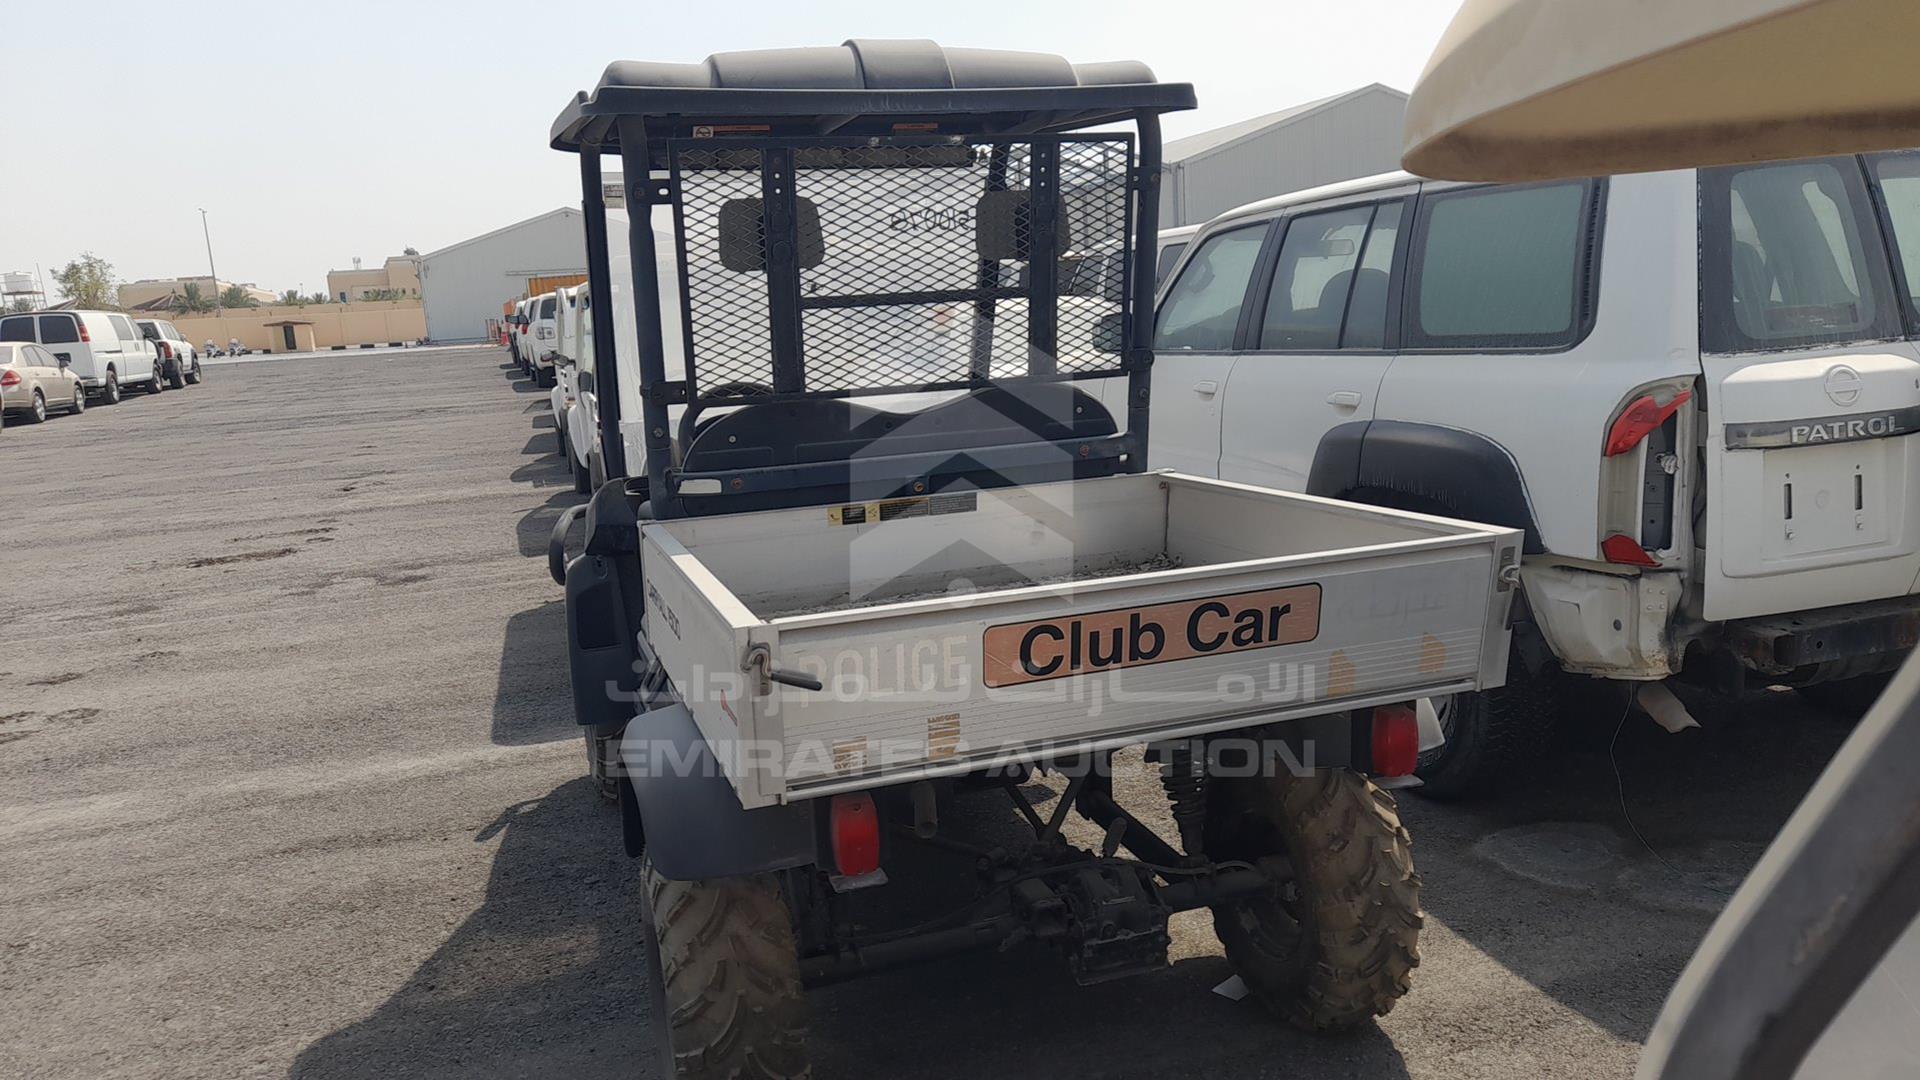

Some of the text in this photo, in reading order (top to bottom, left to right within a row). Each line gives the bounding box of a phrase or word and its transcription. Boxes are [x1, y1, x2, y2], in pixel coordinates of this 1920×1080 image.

[1791, 415, 1905, 443] PATROL
[798, 634, 968, 708] POLICE
[1019, 602, 1292, 677] Club Car
